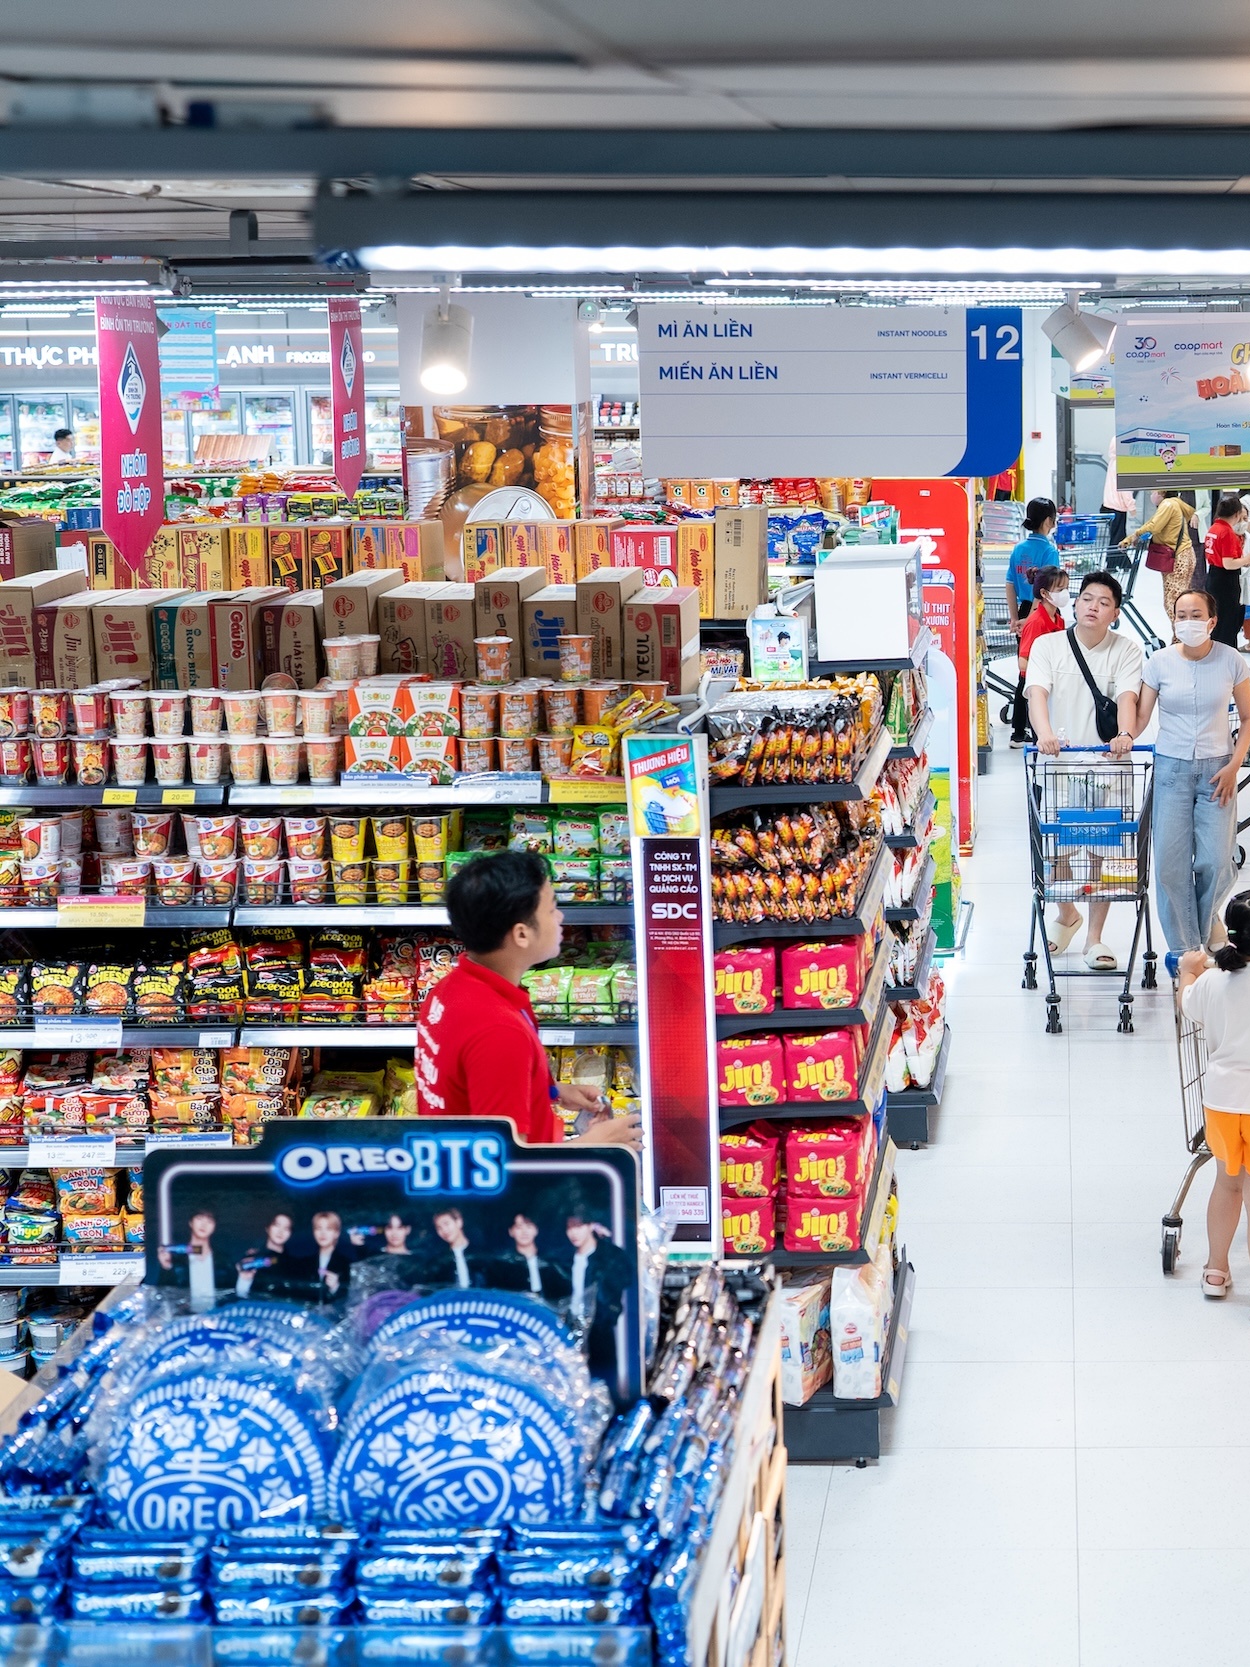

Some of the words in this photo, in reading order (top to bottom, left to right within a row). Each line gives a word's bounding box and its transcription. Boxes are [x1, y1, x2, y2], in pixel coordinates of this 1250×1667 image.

[658, 318, 679, 338] MÌ
[684, 318, 708, 338] ĂN
[713, 317, 753, 338] LIỀN
[877, 329, 909, 338] INSTANT
[911, 329, 948, 338] NOODLES
[970, 324, 1020, 362] 12
[1134, 336, 1157, 351] 30
[1174, 341, 1223, 352] co.opmart
[3, 345, 63, 370] THỰC
[1125, 351, 1166, 360] co.opmart
[659, 361, 703, 381] MIẾN
[709, 361, 733, 381] ĂN
[738, 360, 778, 381] LIỀN
[869, 372, 902, 380] INSTANT
[904, 372, 948, 380] VERMICELLI
[121, 448, 147, 478] NHÓM
[117, 481, 132, 514] ĐỒ
[132, 483, 150, 516] HỘP
[931, 602, 950, 615] THỊT
[185, 629, 196, 659] RONG
[668, 746, 688, 767] HIỆU
[654, 851, 679, 861] CÔNG
[680, 852, 692, 861] TY
[649, 863, 671, 872] TNHH
[672, 863, 698, 872] SX-TM
[654, 874, 661, 883] &
[661, 874, 680, 884] DỊCH
[681, 874, 694, 884] VỤ
[649, 884, 679, 895] QUẢNG
[680, 883, 699, 894] CÁO
[651, 903, 698, 920] SDC
[32, 974, 75, 990] CHEESY
[134, 983, 175, 997] CHEESY
[194, 1066, 217, 1077] Cua
[282, 1146, 414, 1181] OREO
[412, 1138, 500, 1188] BTS
[405, 1469, 499, 1521] OREO
[142, 1495, 243, 1531] OREO
